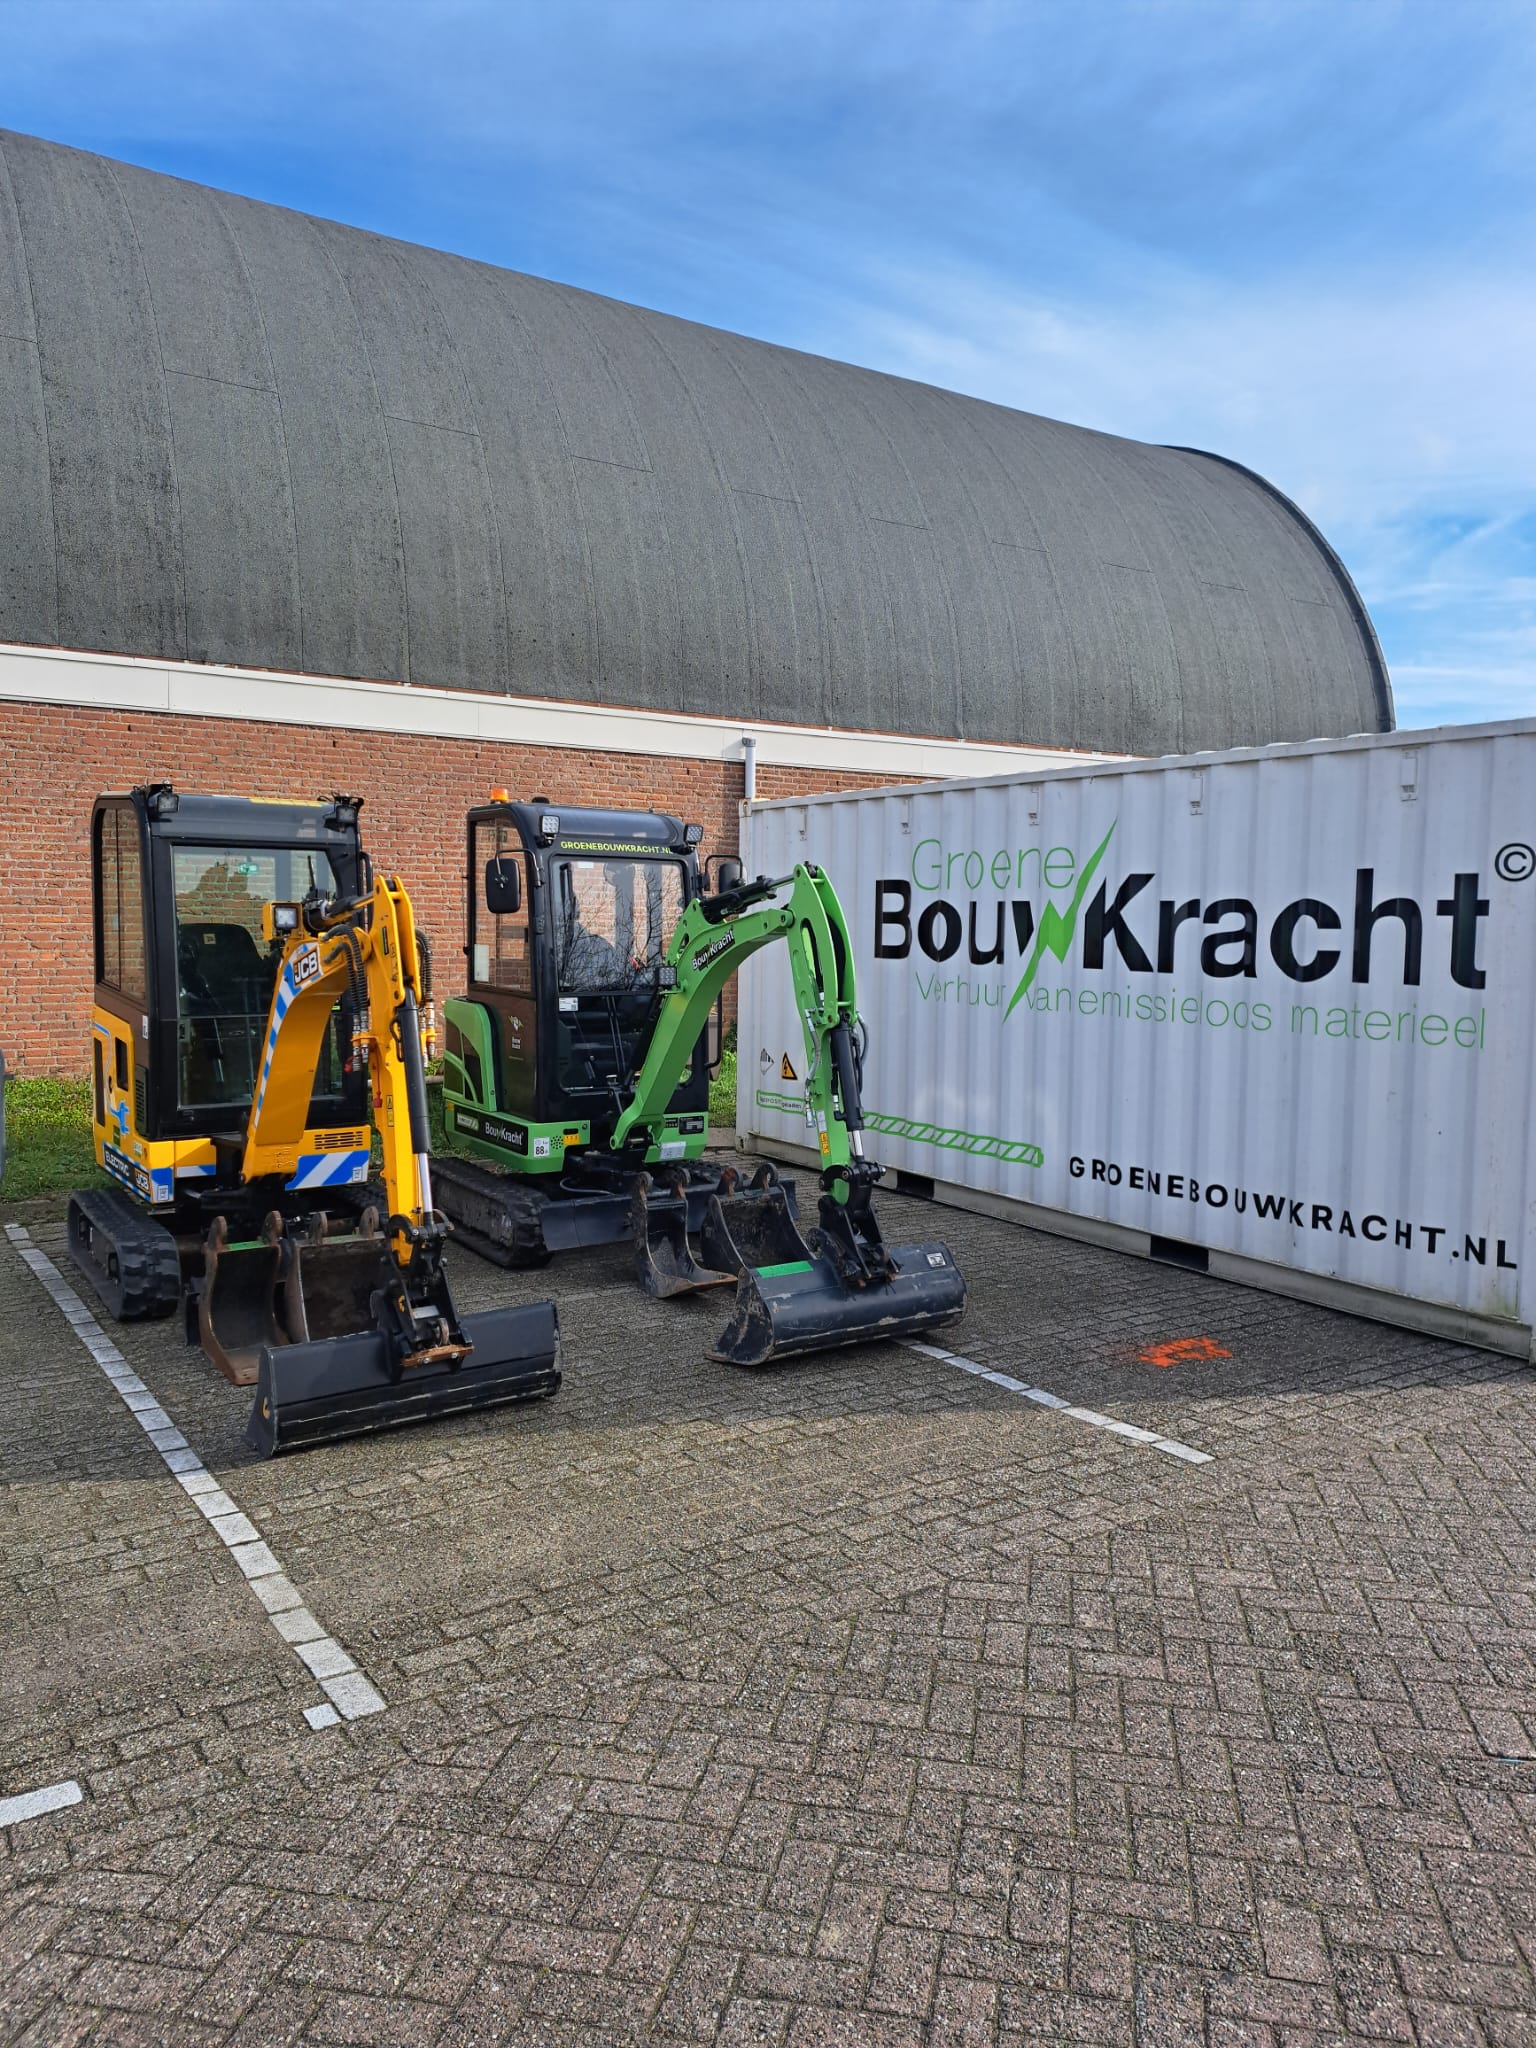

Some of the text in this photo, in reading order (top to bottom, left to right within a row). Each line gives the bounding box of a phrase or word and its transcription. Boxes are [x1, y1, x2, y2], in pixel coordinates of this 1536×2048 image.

[560, 841, 673, 855] GROENEBOUWKRACHT.NL
[911, 838, 1076, 891] Groene
[295, 951, 319, 984] JCB
[914, 971, 1007, 1007] Verhuur
[1291, 1002, 1485, 1049] materieel
[105, 1150, 130, 1177] ELECTRIC
[135, 1173, 149, 1191] JCB
[1068, 1156, 1518, 1269] GROENEBOUWKRACHT.NL
